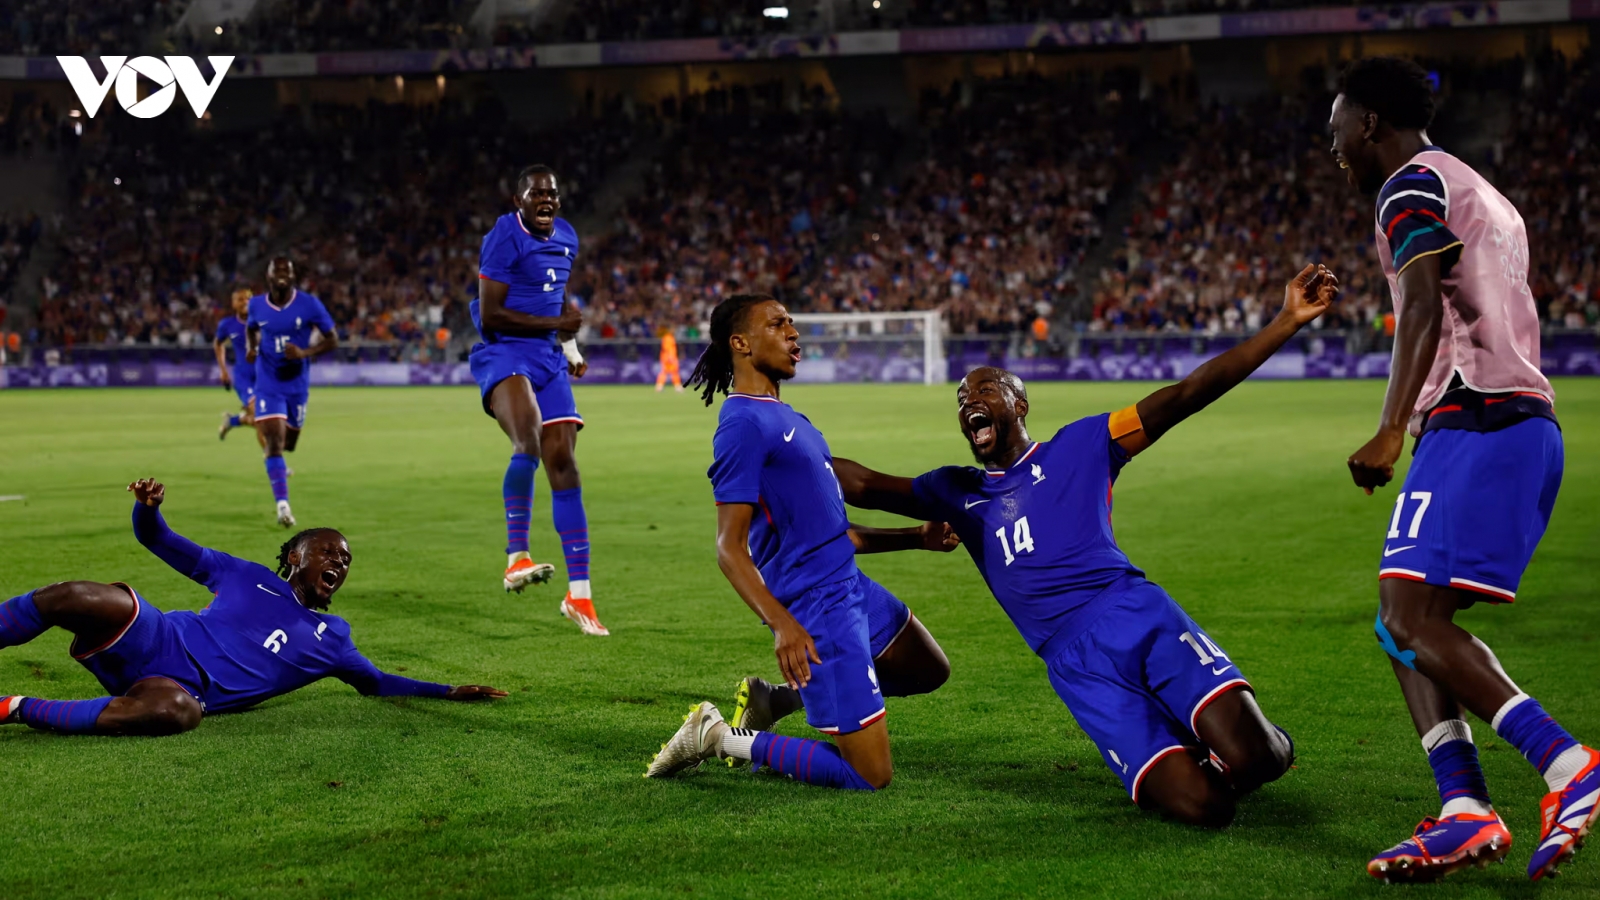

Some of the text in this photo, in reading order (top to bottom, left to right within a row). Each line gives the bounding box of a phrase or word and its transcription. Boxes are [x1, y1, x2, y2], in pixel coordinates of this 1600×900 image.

[543, 268, 557, 291] 2
[1387, 491, 1432, 539] 17
[995, 516, 1035, 567] 14
[263, 629, 288, 654] 6
[1179, 631, 1231, 666] 14
